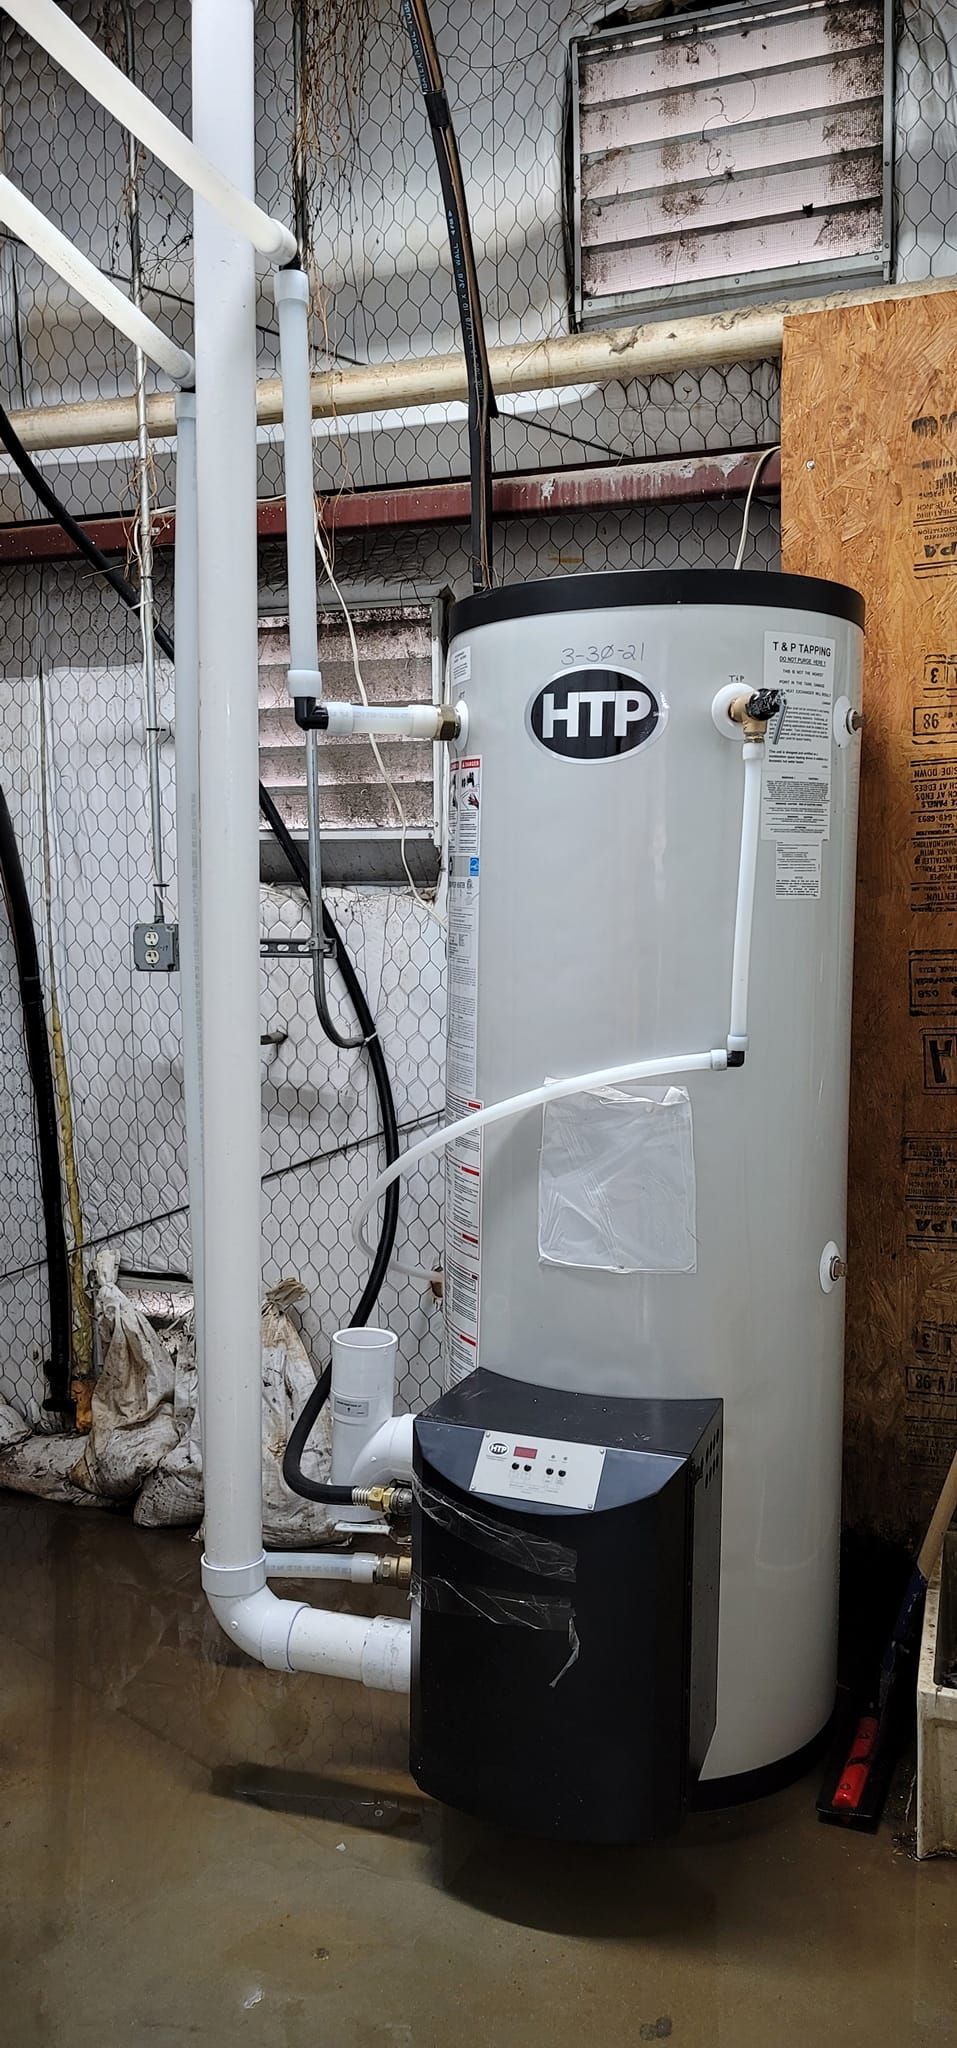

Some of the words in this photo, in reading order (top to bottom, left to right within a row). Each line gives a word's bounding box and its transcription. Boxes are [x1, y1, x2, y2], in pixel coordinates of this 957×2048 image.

[453, 243, 461, 266] WALL
[772, 641, 779, 651] T
[781, 641, 788, 652] &
[790, 642, 797, 652] P
[798, 643, 831, 657] TAPPING
[779, 655, 787, 663] DO
[787, 656, 797, 664] NOT
[930, 667, 940, 684] 3
[541, 691, 652, 738] HTP
[923, 712, 939, 730] 98
[913, 768, 938, 779] DOWN
[490, 1444, 507, 1455] HTP
